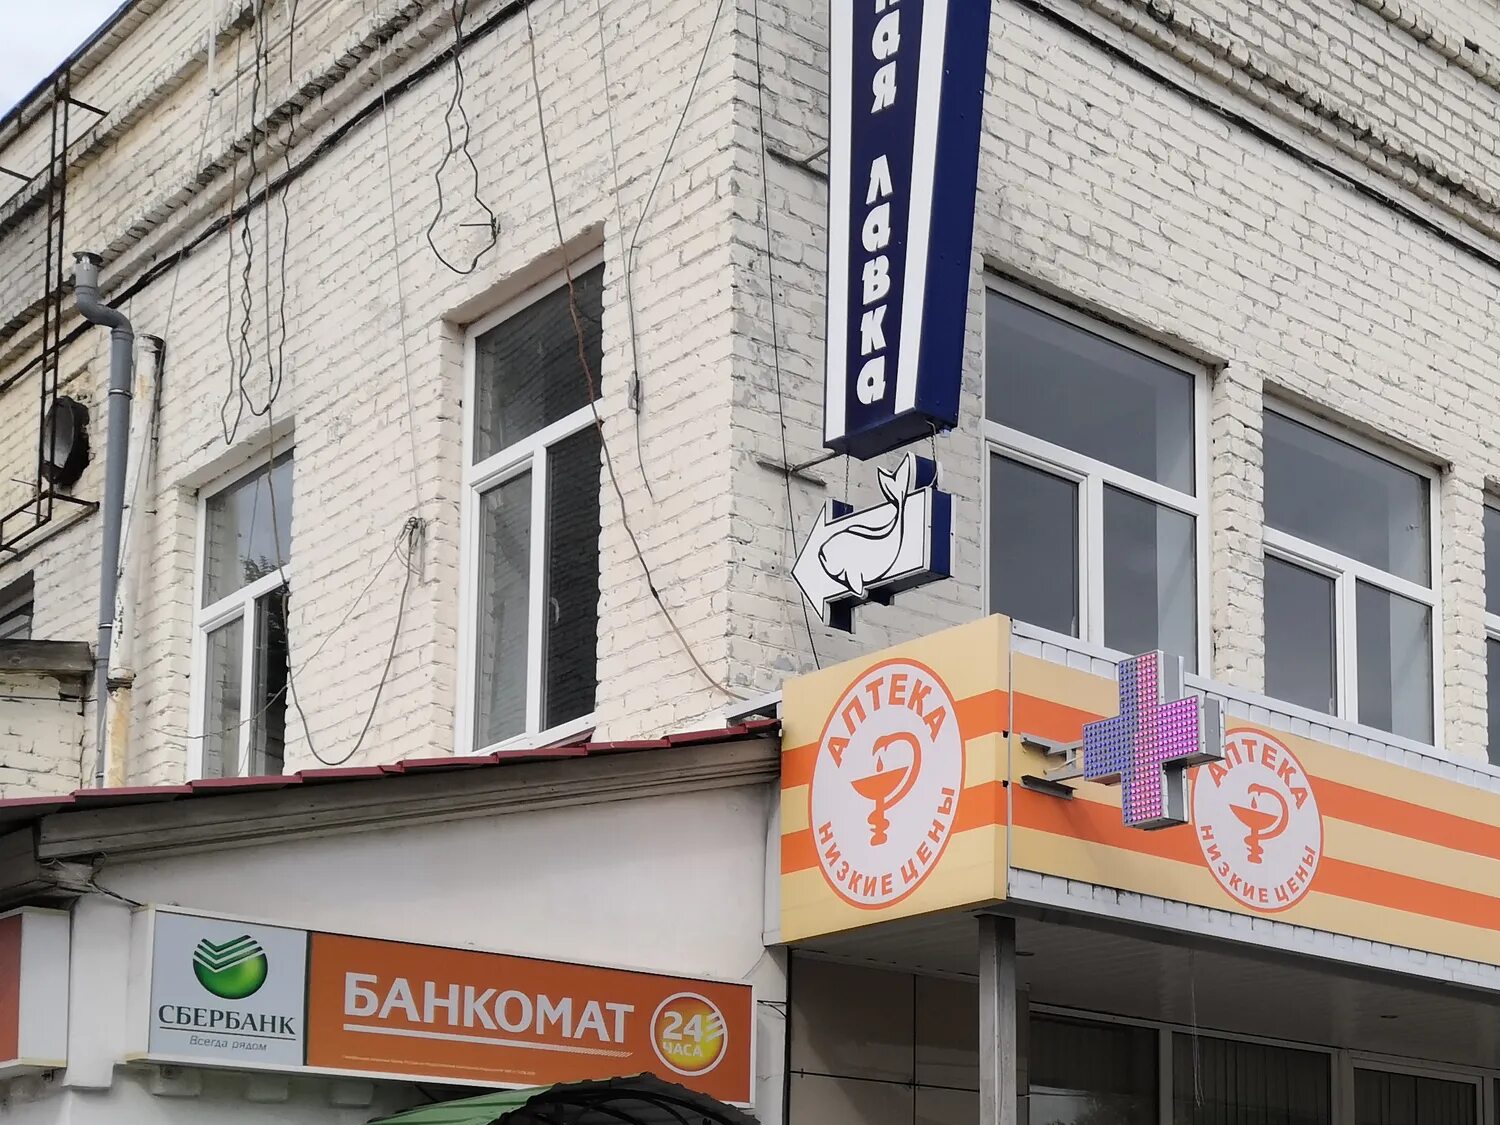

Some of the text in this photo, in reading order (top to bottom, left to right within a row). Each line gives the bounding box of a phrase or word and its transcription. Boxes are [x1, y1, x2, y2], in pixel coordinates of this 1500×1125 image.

[870, 0, 901, 114] ая
[827, 673, 947, 768] АПТЕКА
[1207, 738, 1309, 810] АПТЕКА
[818, 787, 955, 897] НИЗКИЕ ЦЕНЫ
[1200, 825, 1316, 903] НИЗКИЕ ЦЕНЫ
[158, 1004, 296, 1036] СБЕРБАНК
[189, 1035, 268, 1052] Всегда рядом
[343, 971, 635, 1044] БАНКОМАТ
[663, 1010, 704, 1043] 24
[662, 1041, 704, 1057] ЧАСА
